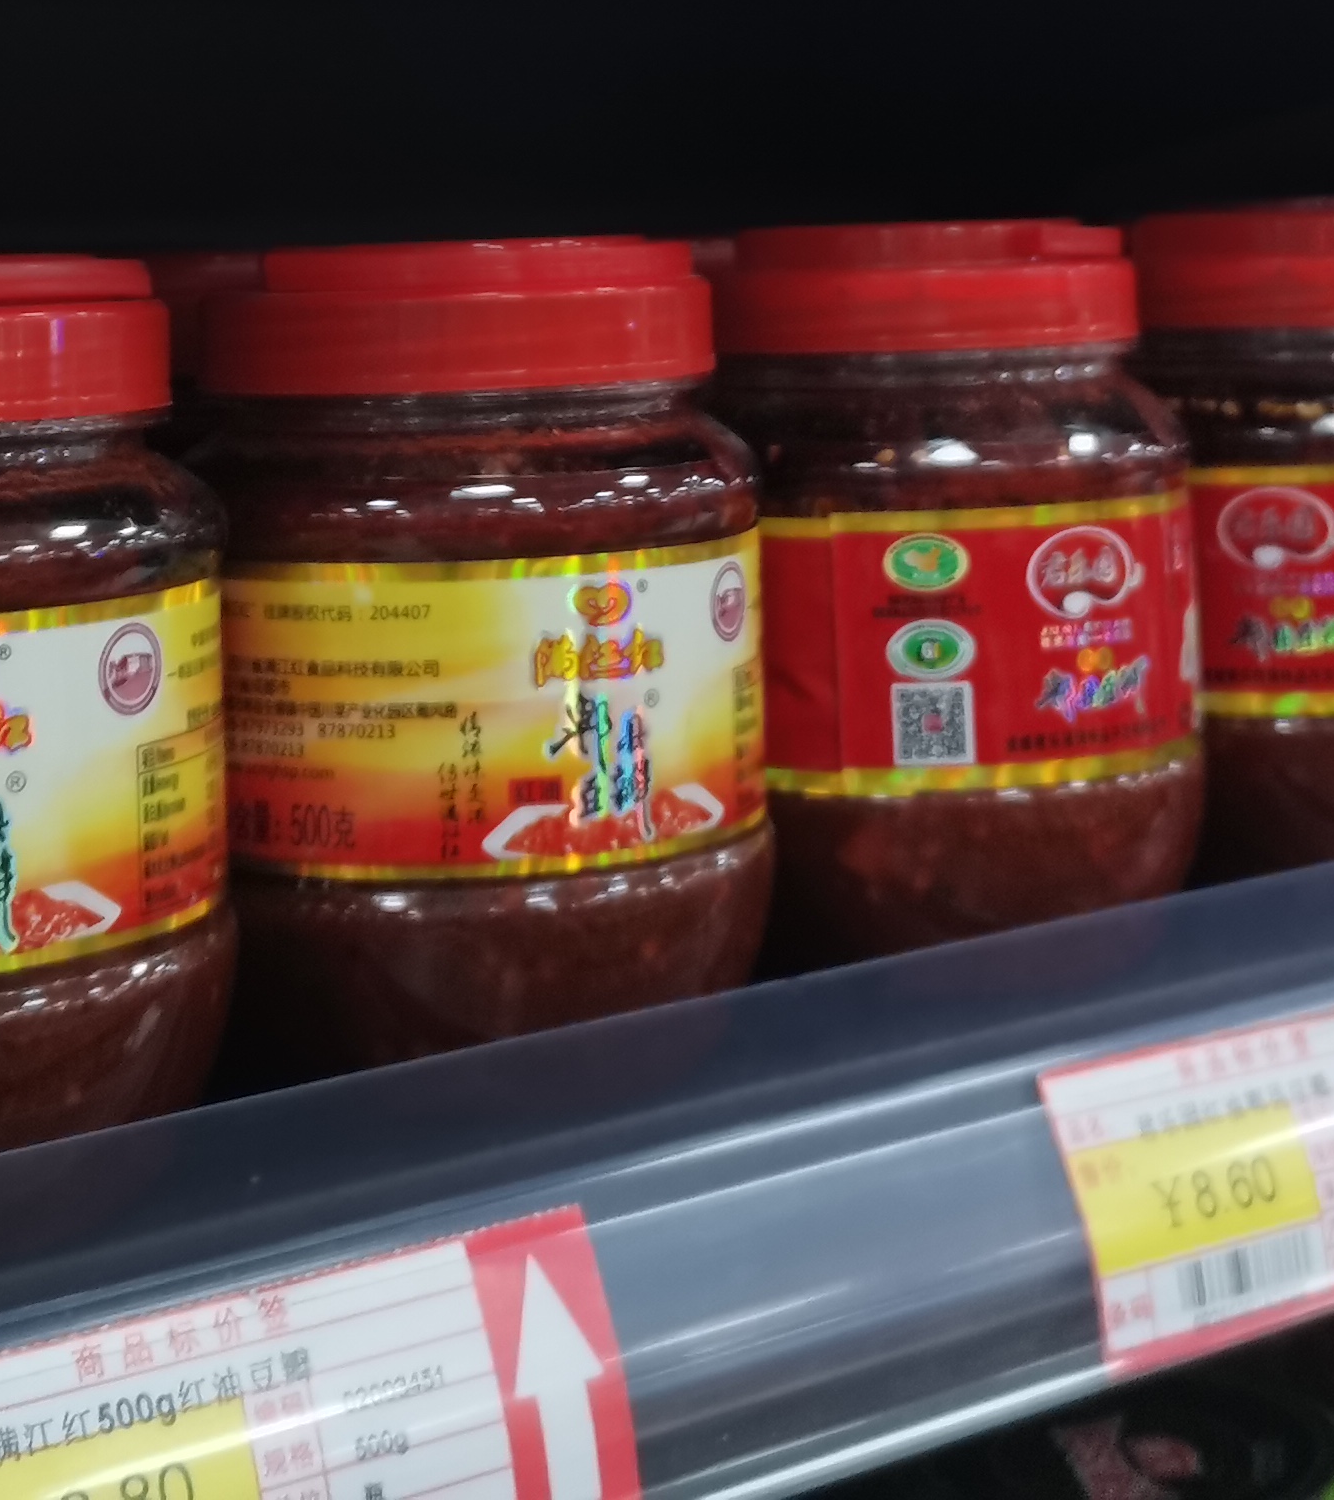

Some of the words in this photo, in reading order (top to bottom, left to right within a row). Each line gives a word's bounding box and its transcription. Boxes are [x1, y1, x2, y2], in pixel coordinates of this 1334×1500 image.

[370, 604, 431, 620] 204407
[318, 722, 396, 739] 87870213
[73, 1294, 292, 1383] 商品标价签
